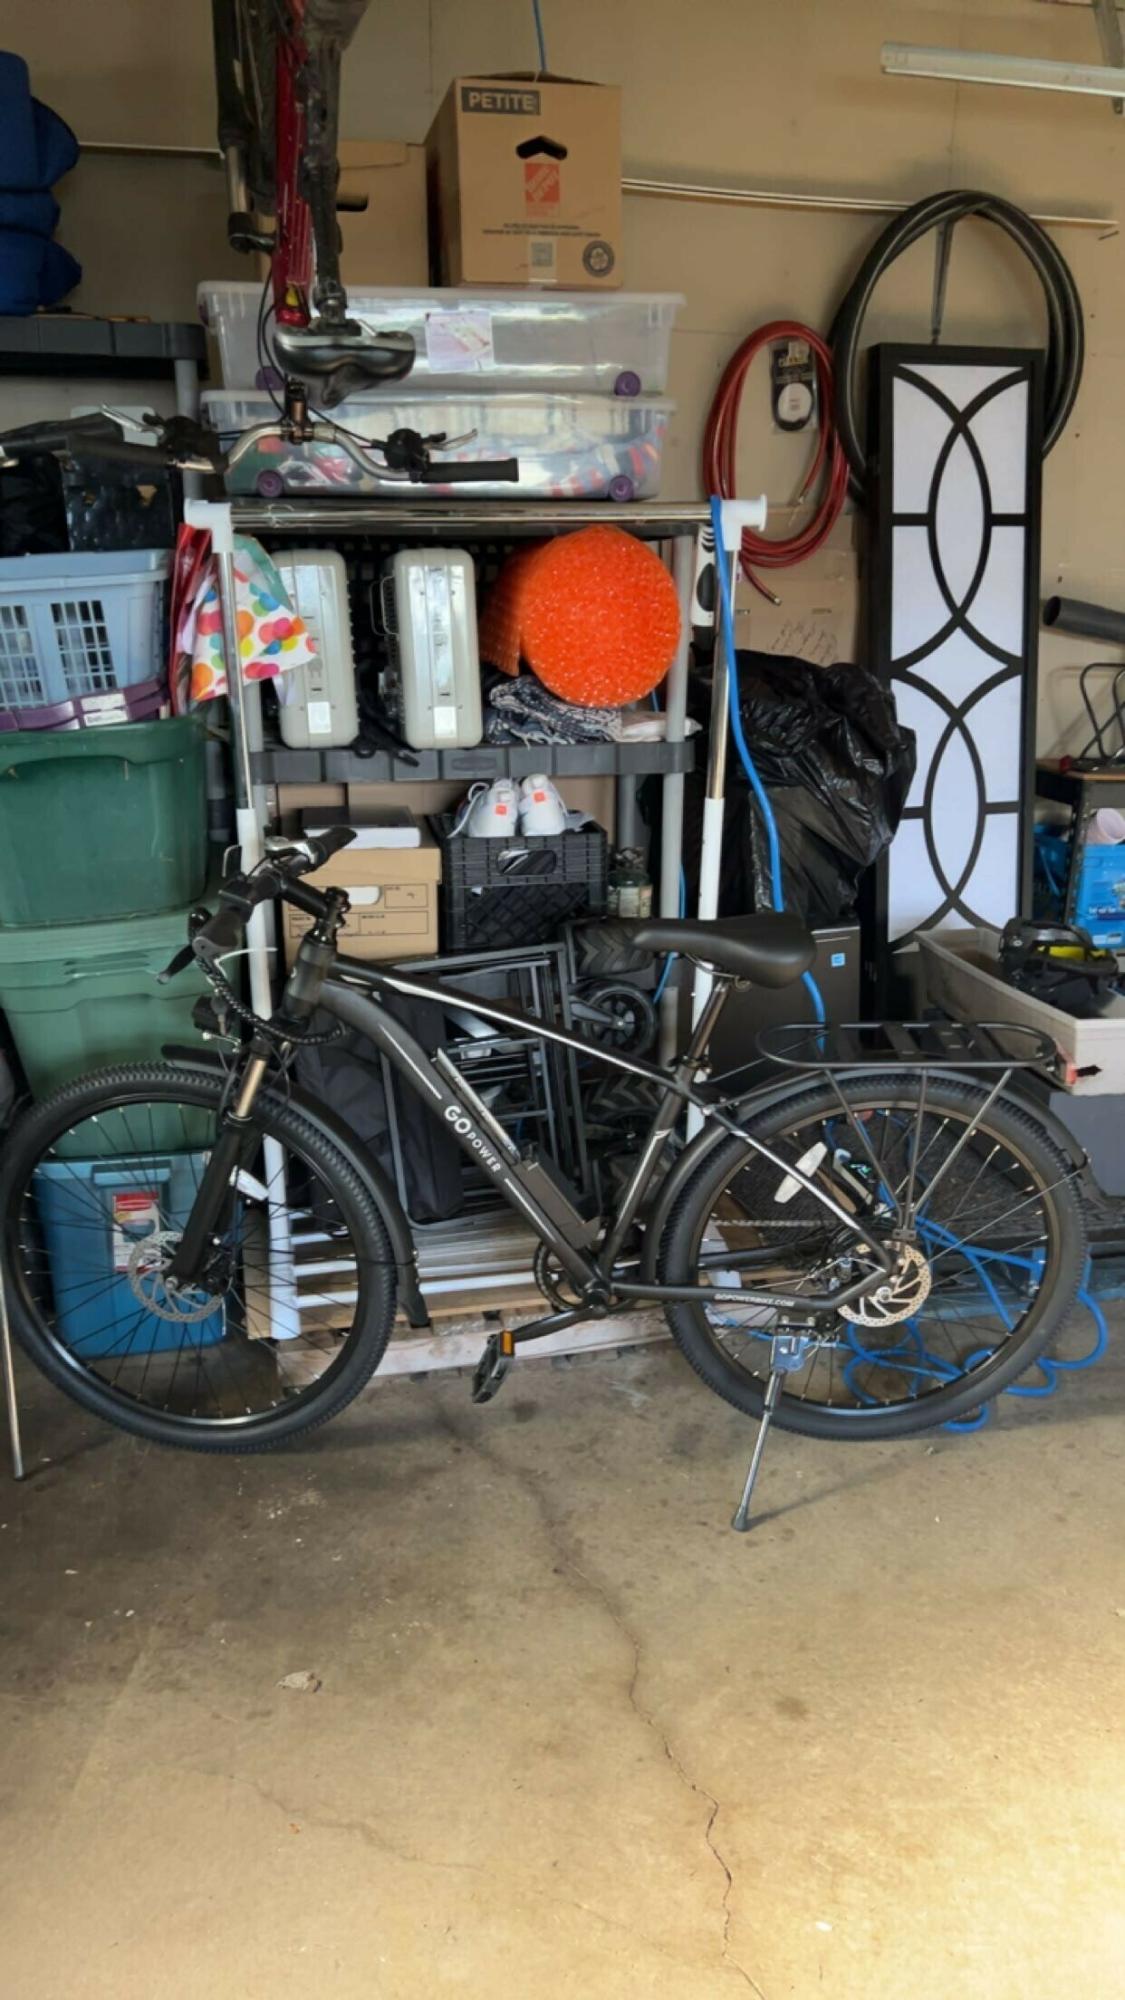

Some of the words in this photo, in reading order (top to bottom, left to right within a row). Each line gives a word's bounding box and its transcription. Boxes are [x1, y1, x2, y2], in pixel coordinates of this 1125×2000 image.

[468, 91, 536, 111] PETITE
[444, 1105, 472, 1134] GO
[466, 1131, 501, 1172] POWER
